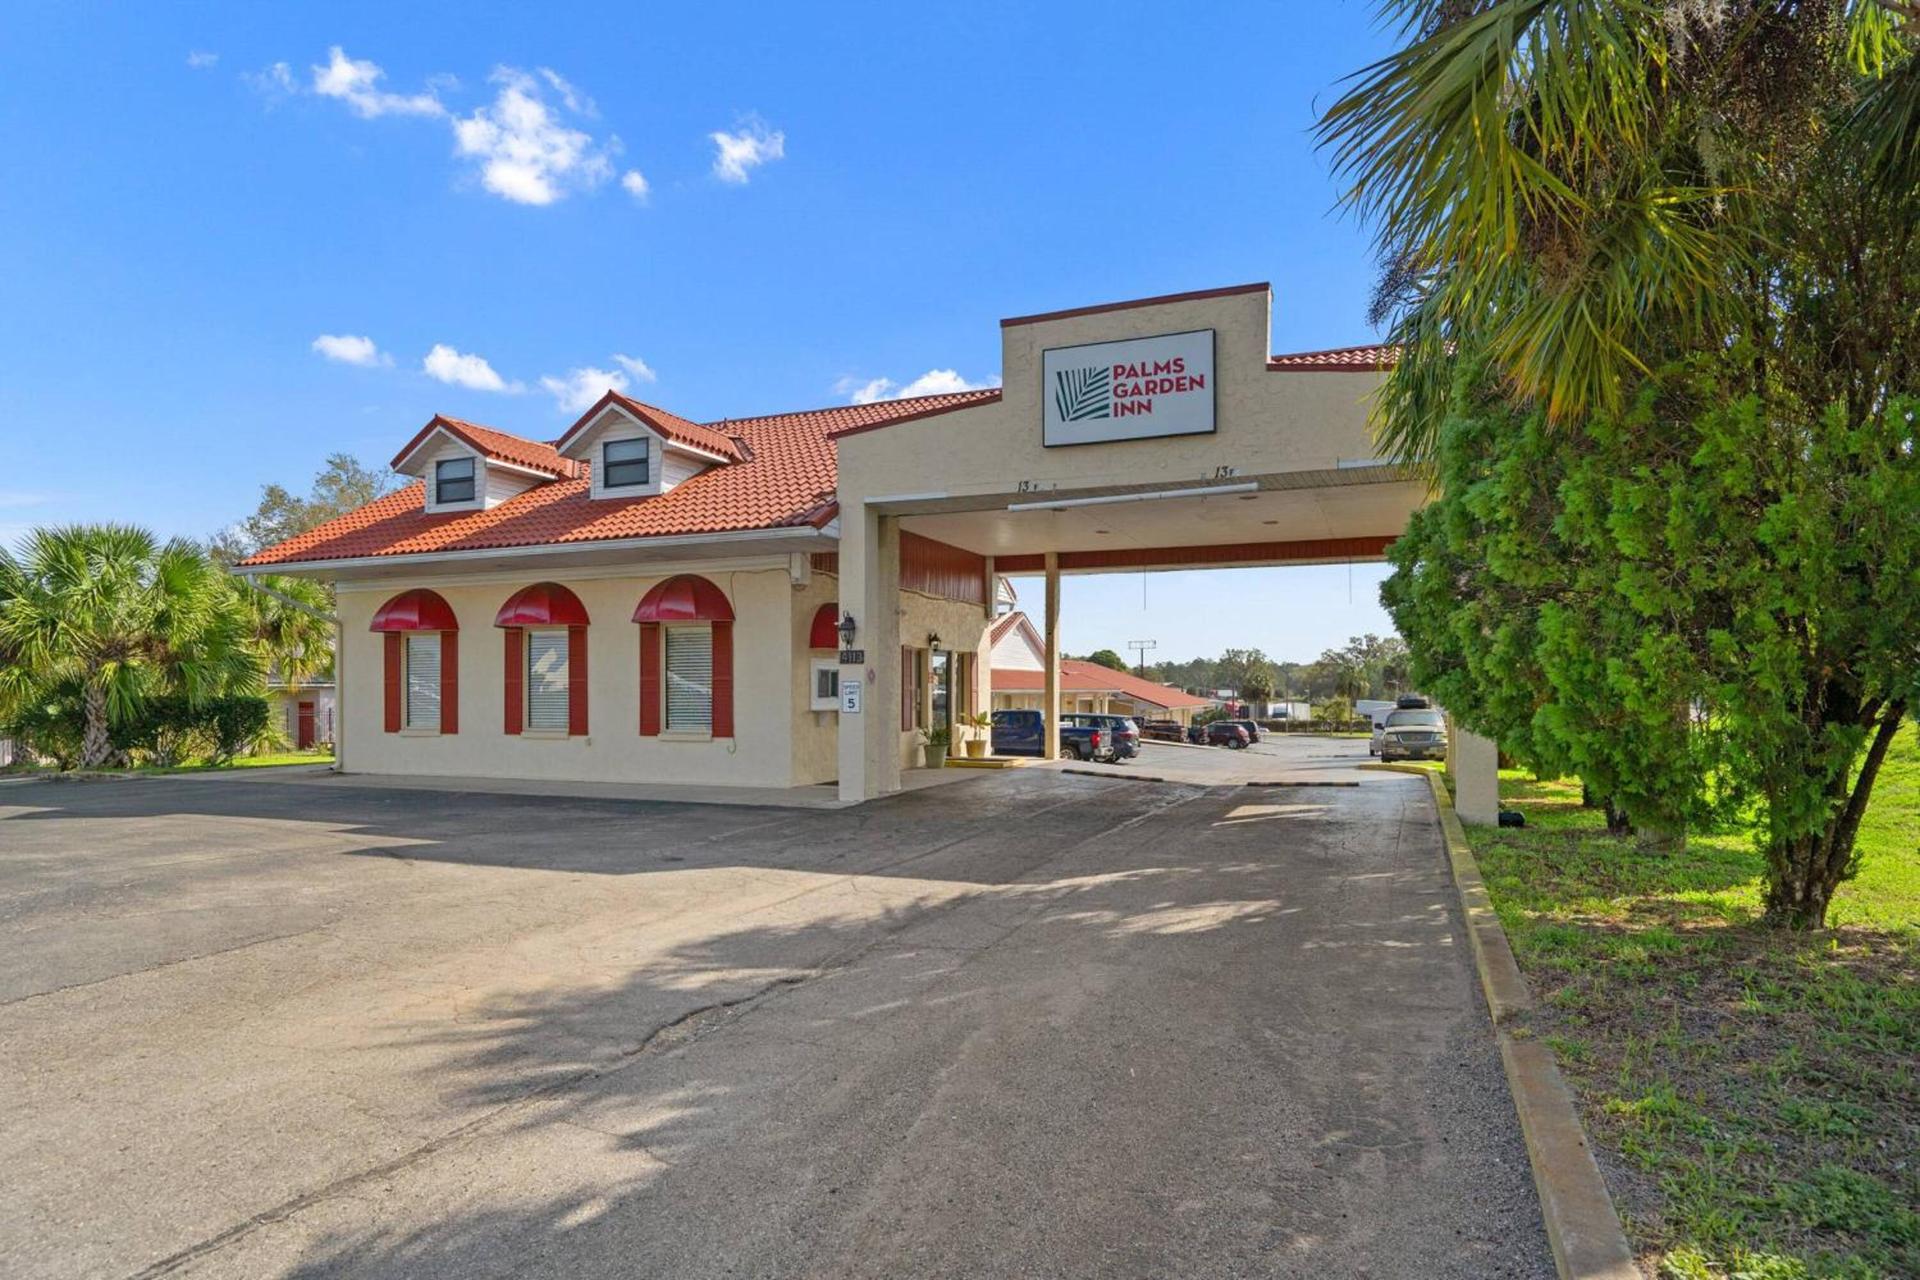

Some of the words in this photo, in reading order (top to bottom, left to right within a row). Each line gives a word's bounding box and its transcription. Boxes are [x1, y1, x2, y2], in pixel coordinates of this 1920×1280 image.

[1113, 357, 1185, 380] PALMS
[1113, 373, 1205, 398] GARDEN
[1113, 399, 1152, 417] INN
[848, 698, 856, 709] 5
